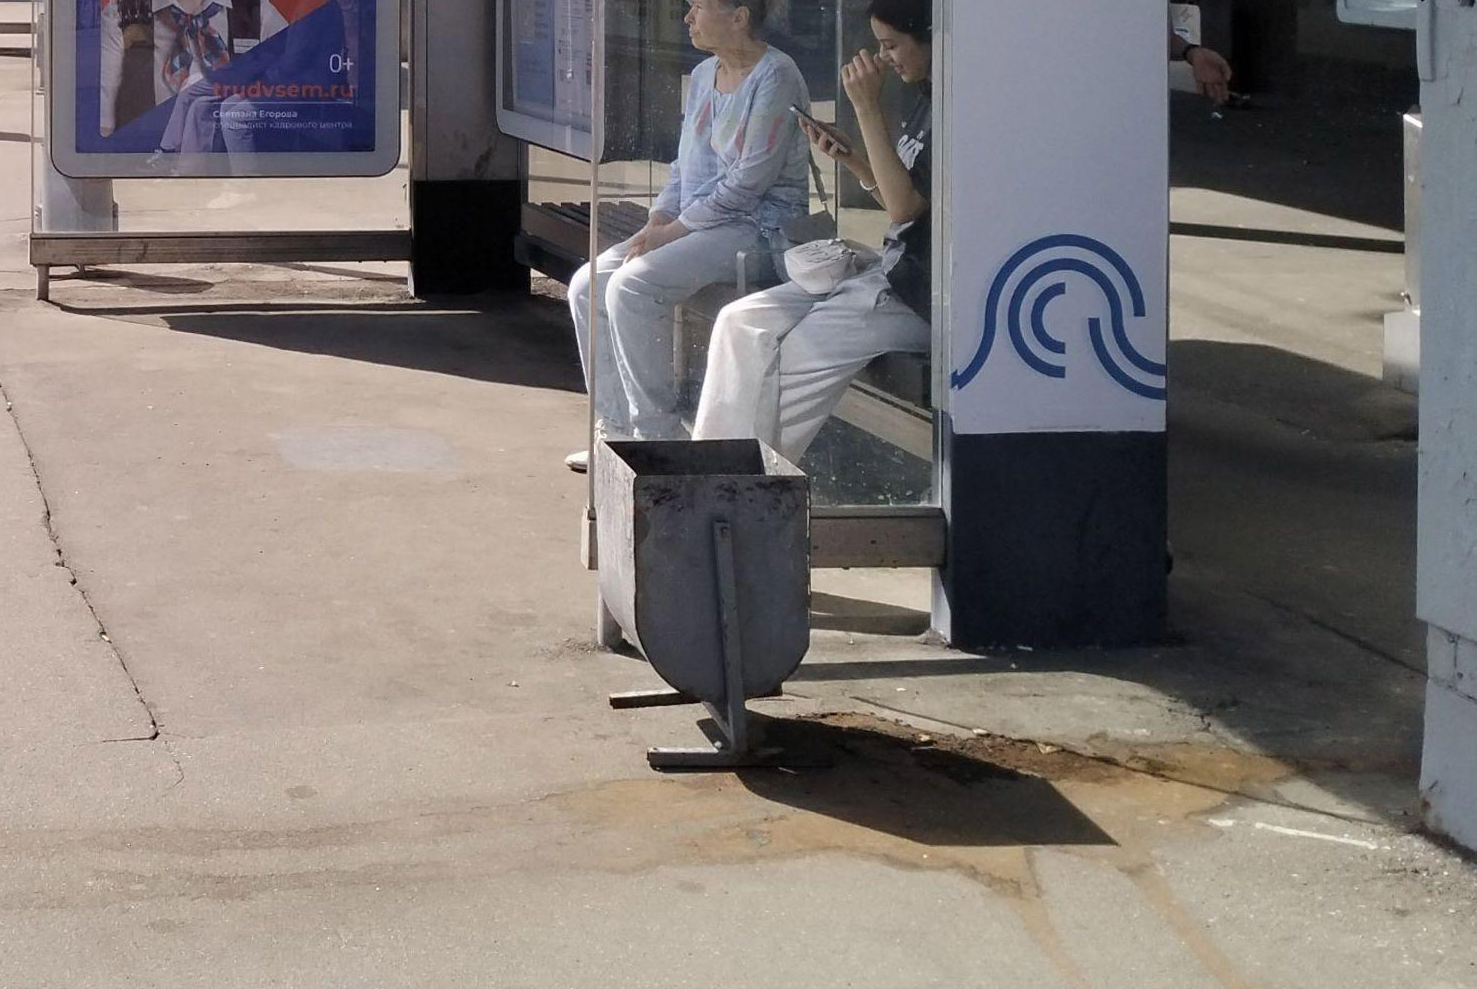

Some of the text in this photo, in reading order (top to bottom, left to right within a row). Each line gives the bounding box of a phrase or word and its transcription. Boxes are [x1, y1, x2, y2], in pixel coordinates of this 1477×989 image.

[329, 54, 354, 73] 0+
[213, 81, 355, 99] trudvsem.ru
[259, 109, 298, 120] Егорова
